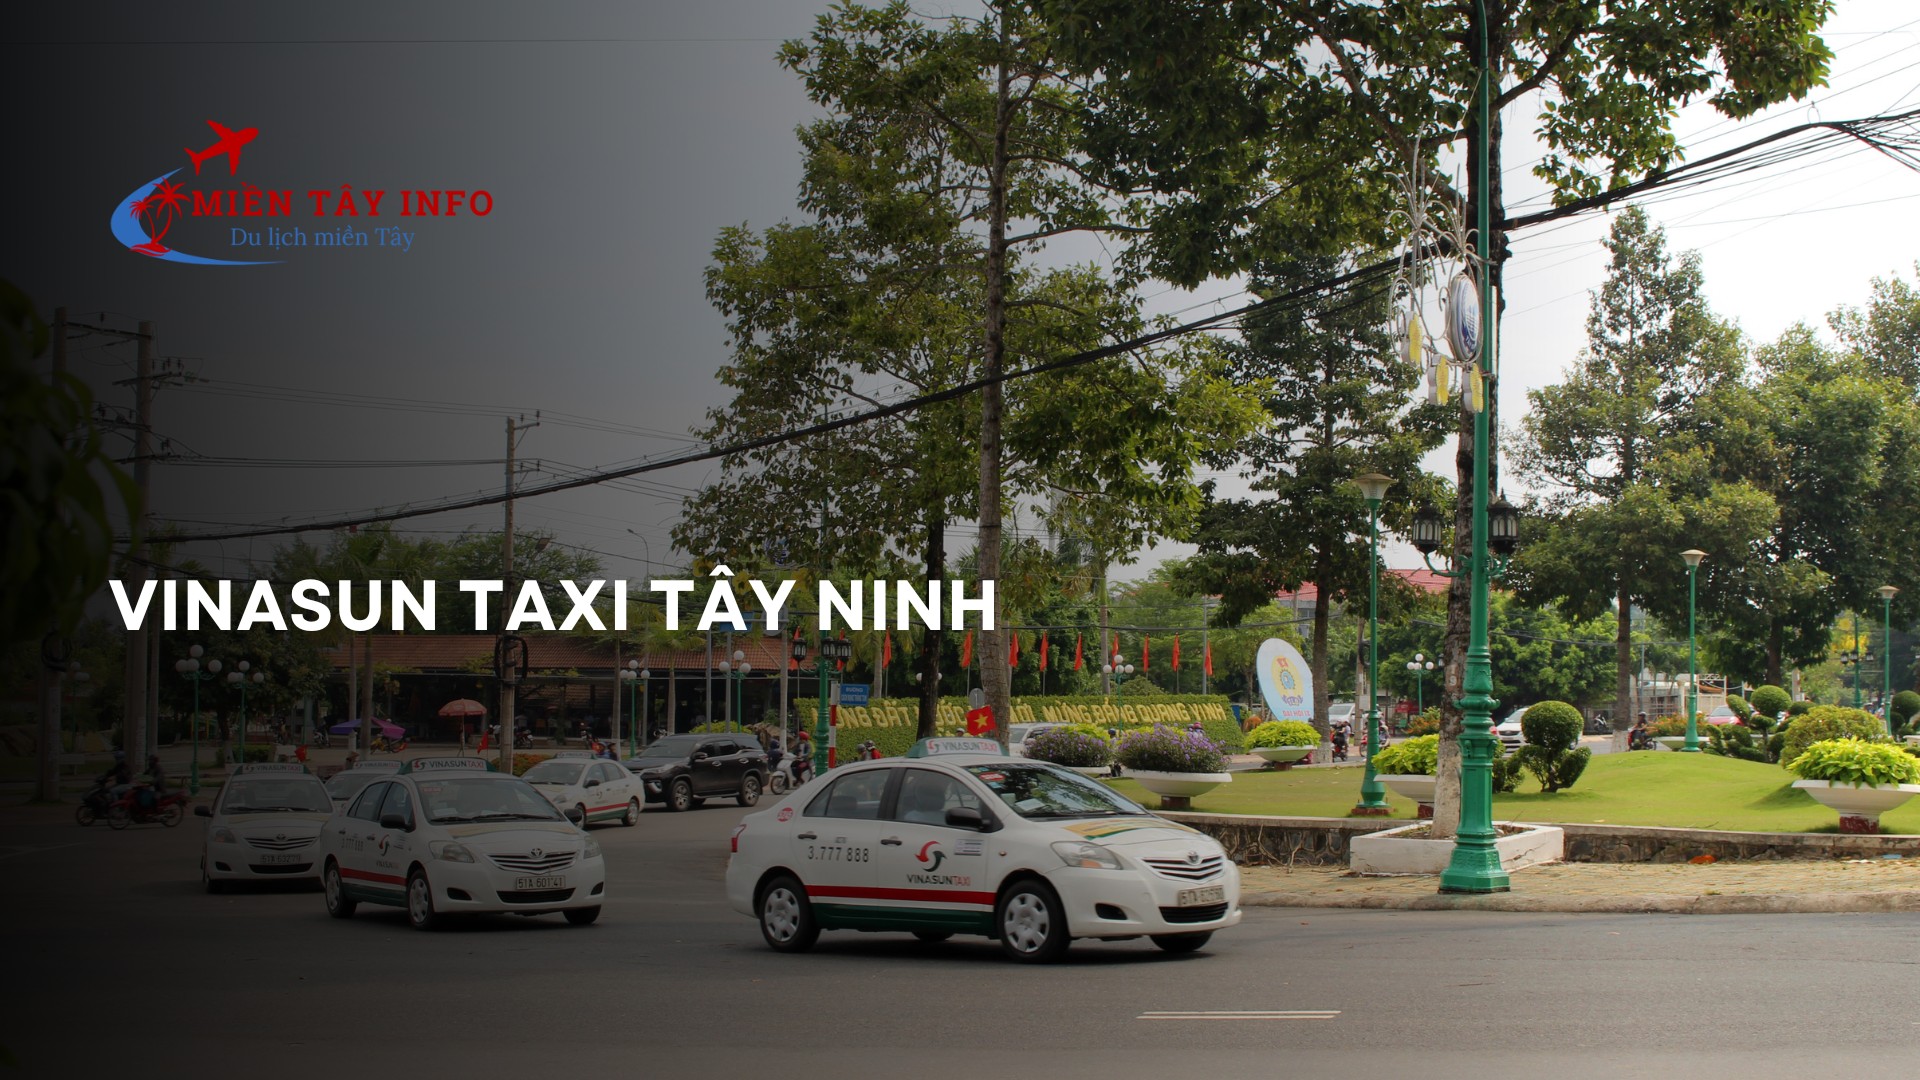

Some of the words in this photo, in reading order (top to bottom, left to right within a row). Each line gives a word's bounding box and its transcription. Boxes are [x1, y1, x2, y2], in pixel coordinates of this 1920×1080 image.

[1139, 703, 1191, 723] QUANG
[808, 845, 842, 861] 3.777
[846, 847, 869, 862] 888
